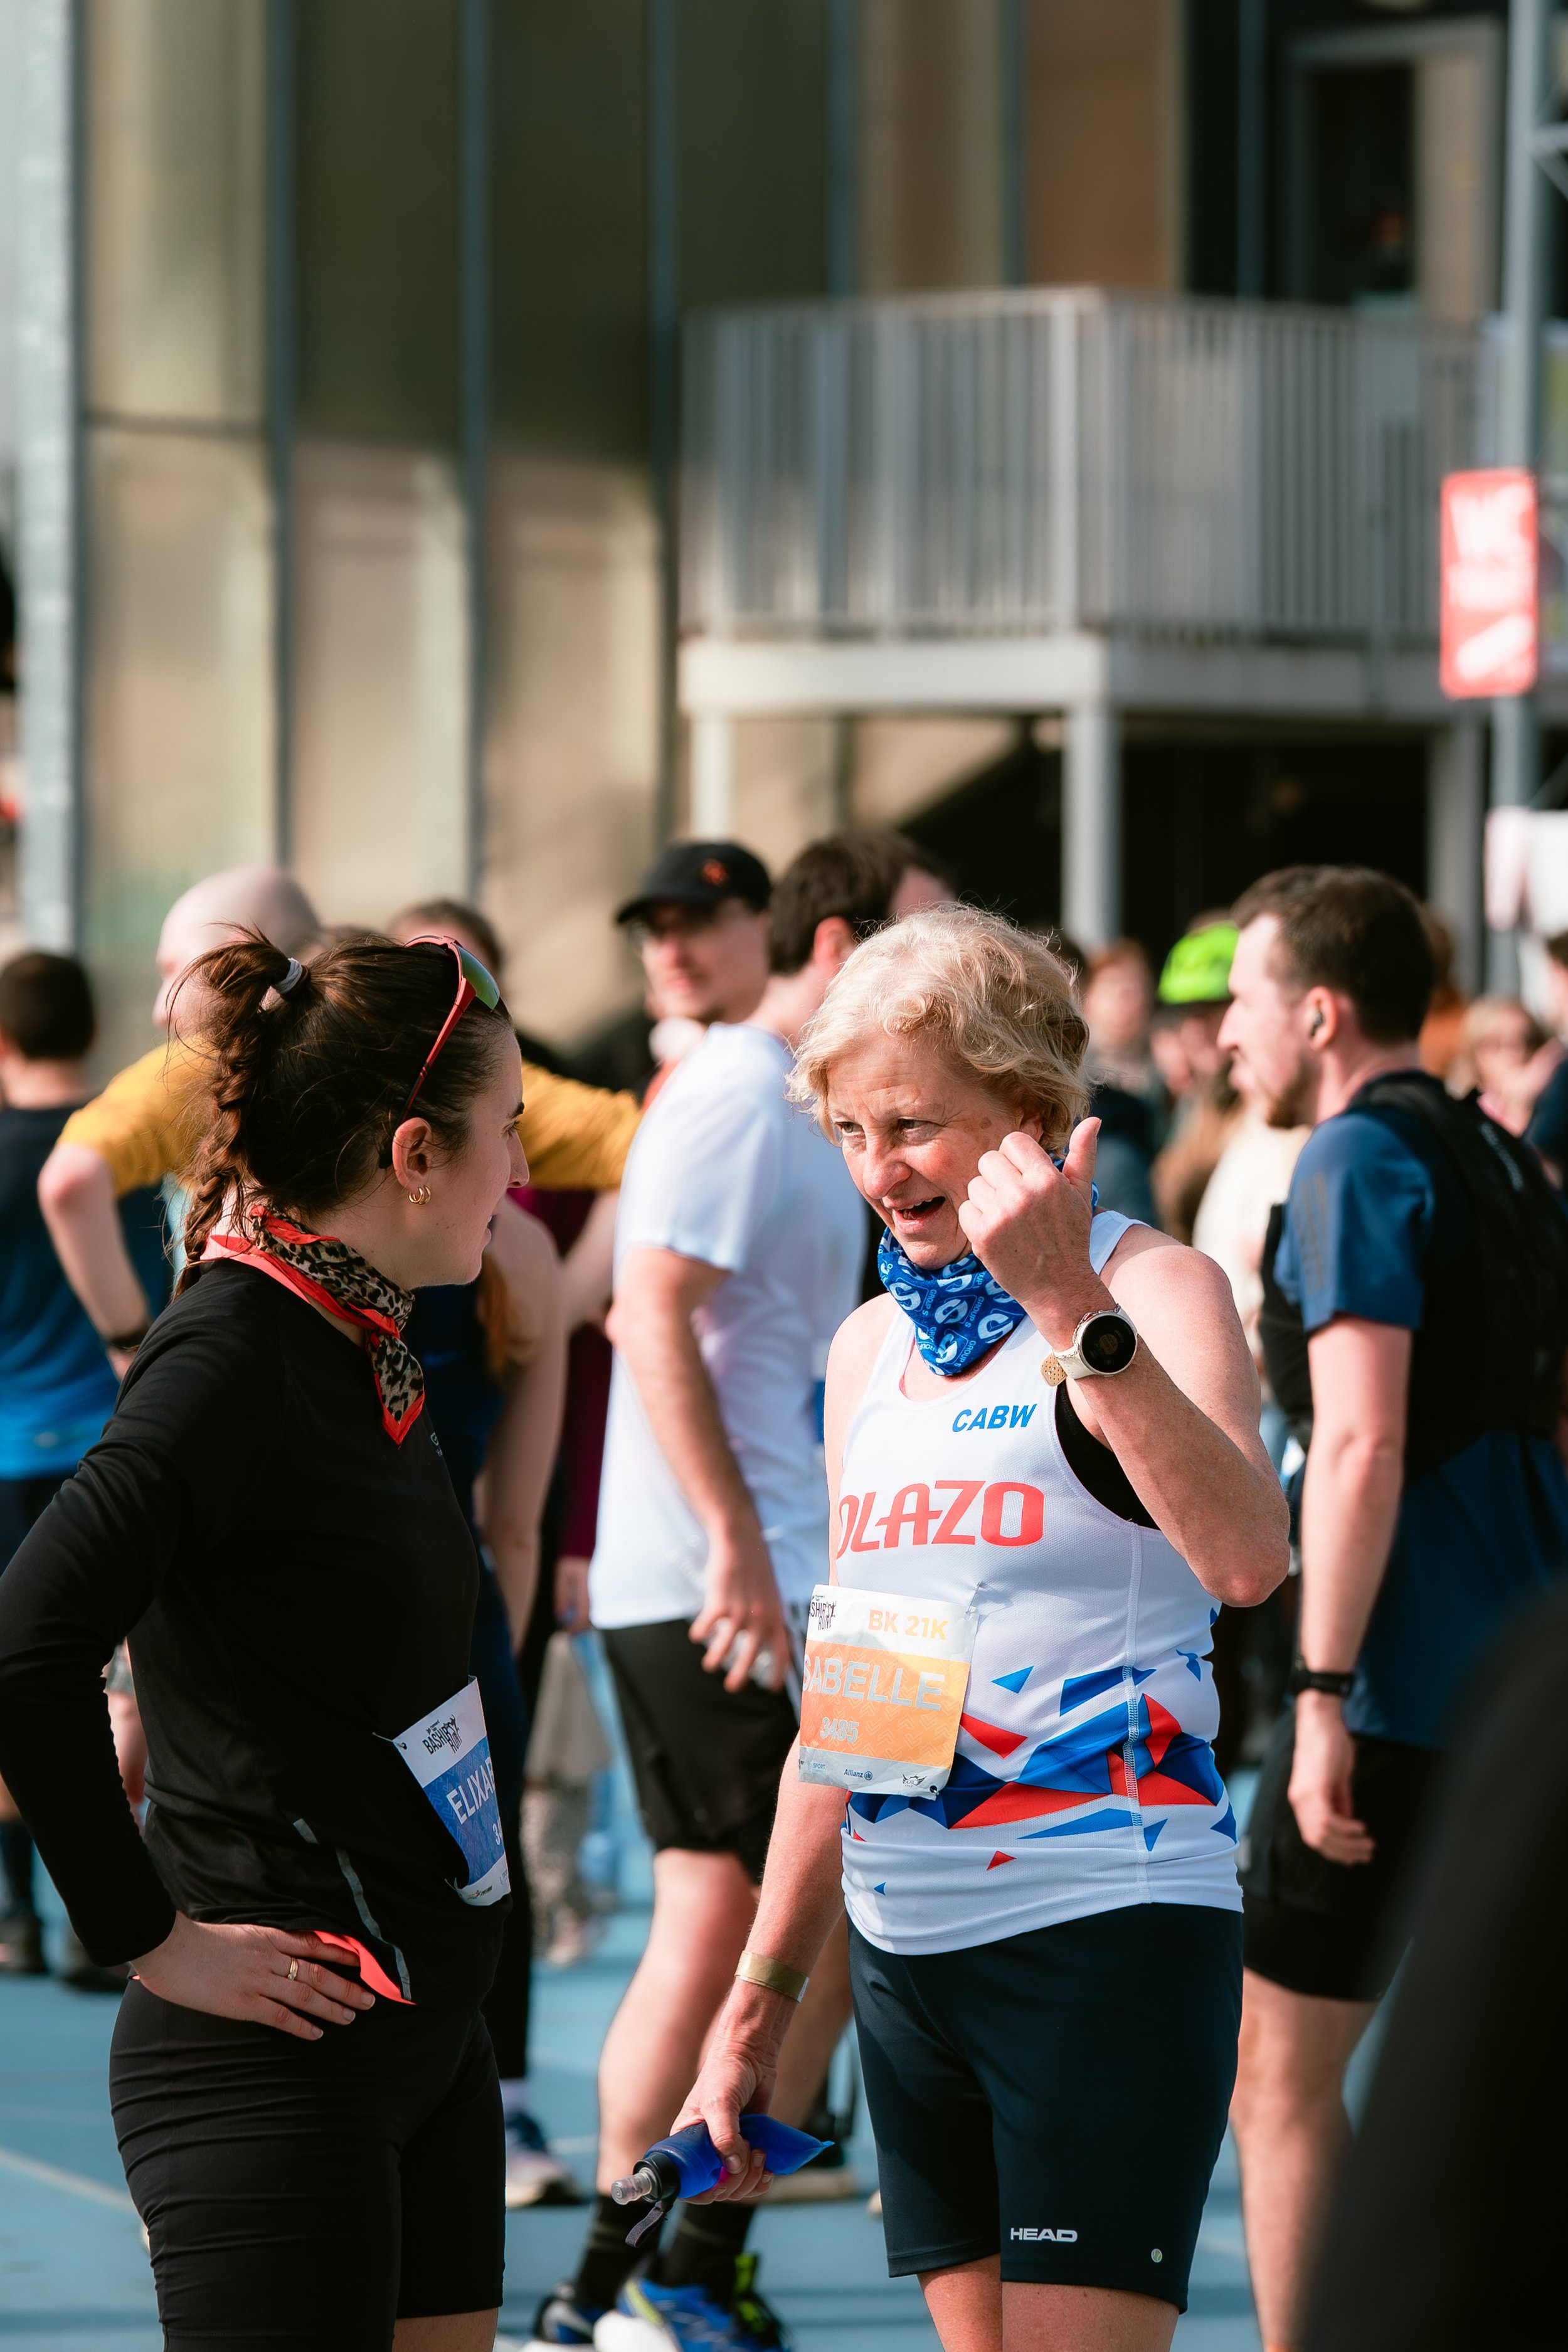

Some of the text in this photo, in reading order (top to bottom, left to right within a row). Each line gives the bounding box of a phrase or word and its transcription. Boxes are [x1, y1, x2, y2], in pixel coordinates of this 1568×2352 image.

[926, 1289, 937, 1310] GROUP
[969, 1296, 984, 1322] GROUP
[960, 1340, 977, 1363] GROUP
[952, 1404, 1037, 1433] CABW
[868, 1609, 950, 1641] BK 21K
[820, 1717, 859, 1743] 3485
[844, 1769, 864, 1778] Allianz
[1010, 2227, 1078, 2243] HEAD
